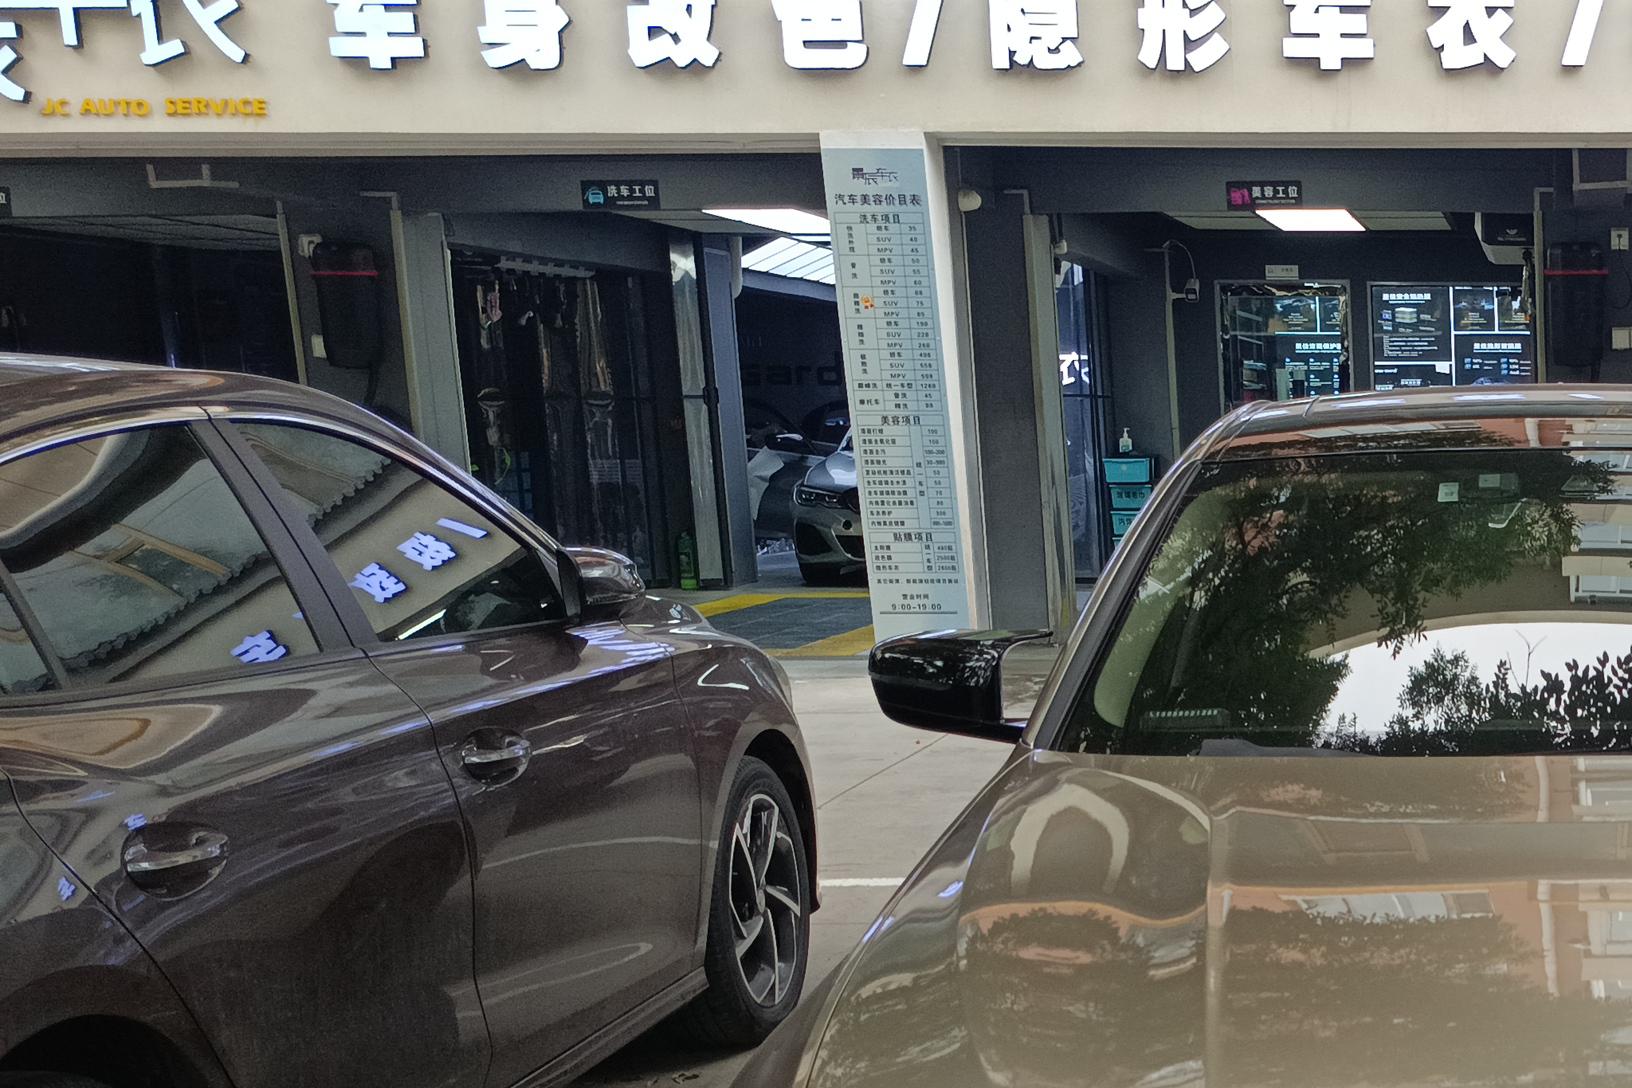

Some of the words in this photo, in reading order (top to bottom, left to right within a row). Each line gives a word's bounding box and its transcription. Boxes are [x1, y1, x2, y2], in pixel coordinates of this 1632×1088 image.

[41, 97, 71, 117] JC
[80, 97, 151, 117] AUTO
[165, 97, 268, 117] SERVICE
[607, 185, 656, 197] 洗车工位
[1251, 185, 1298, 198] 美容工位
[834, 193, 923, 207] 汽车美容价目表
[857, 213, 900, 223] 洗车项目
[880, 415, 921, 425] 美容项目
